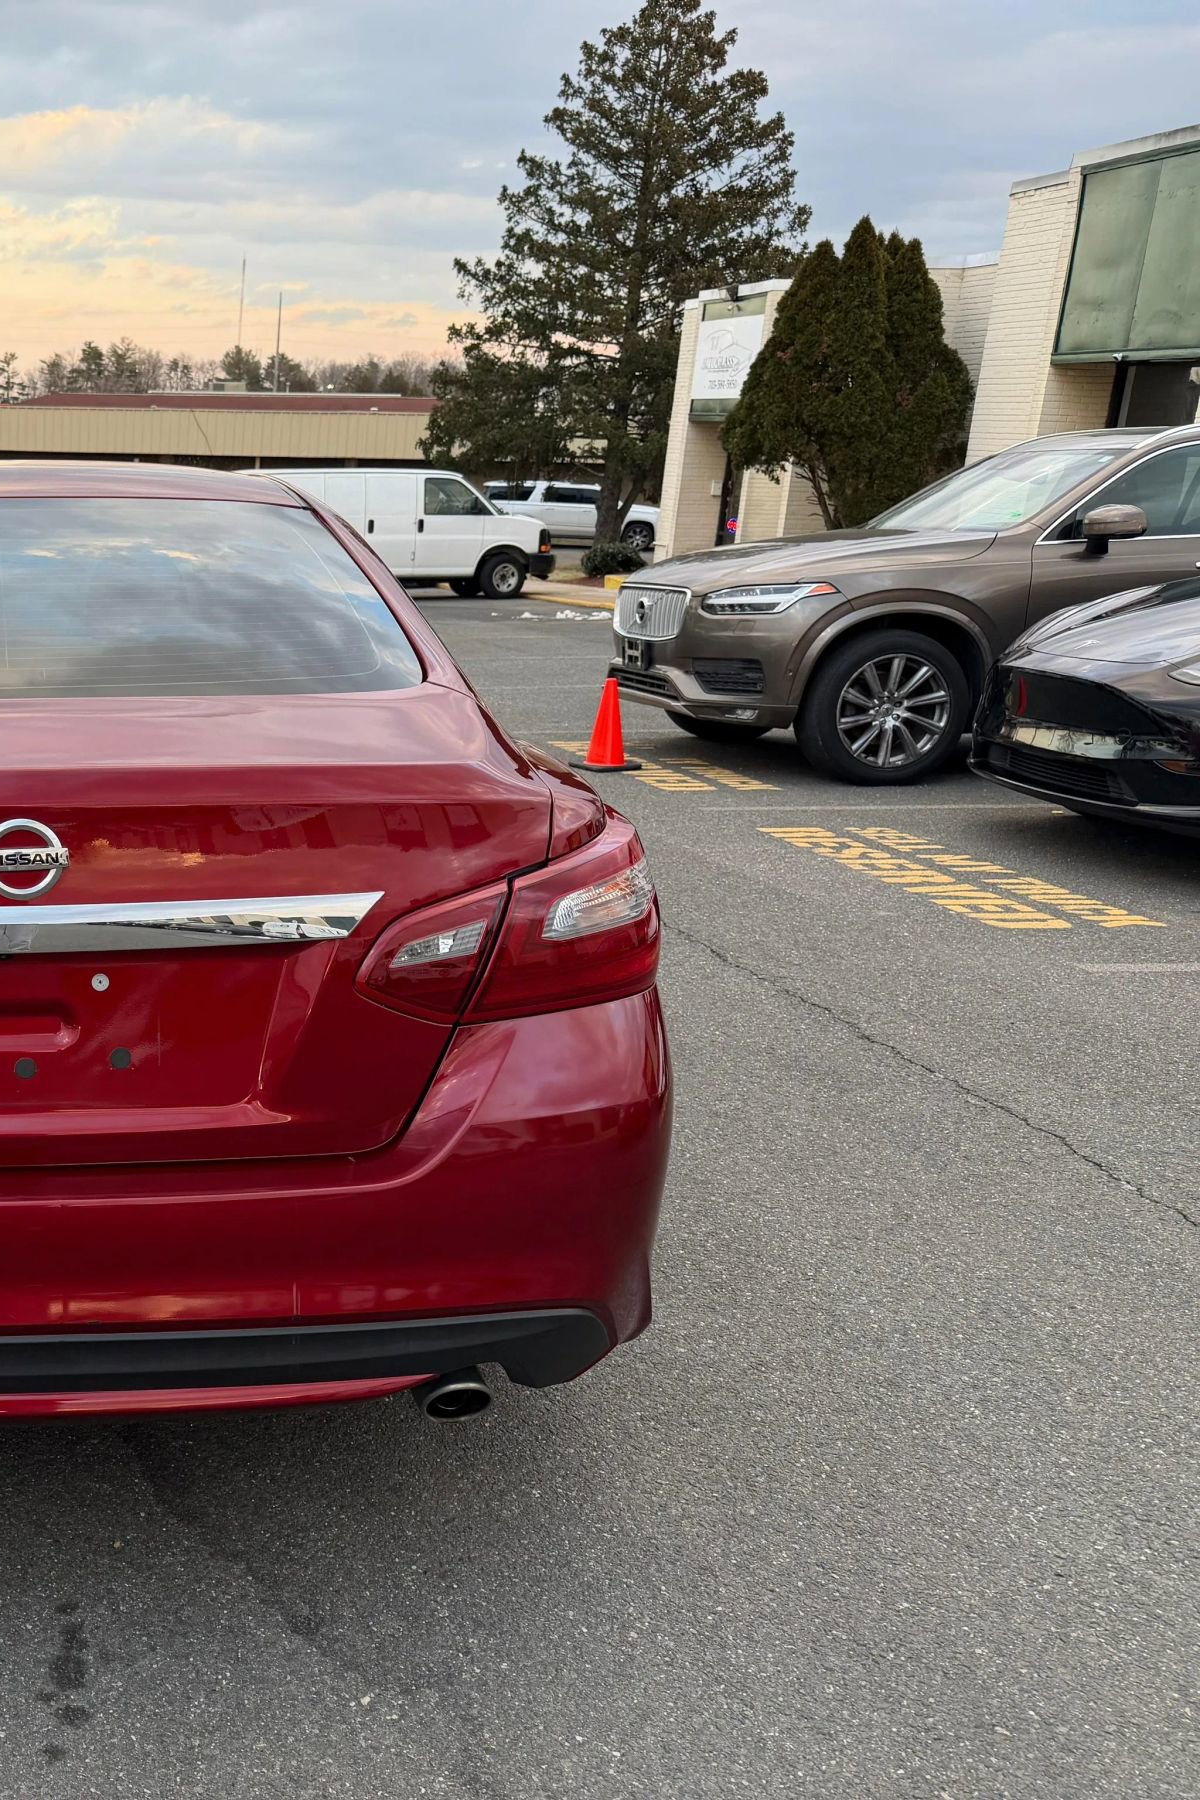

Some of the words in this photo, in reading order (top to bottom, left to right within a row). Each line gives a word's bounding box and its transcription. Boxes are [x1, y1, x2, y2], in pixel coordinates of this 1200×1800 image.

[756, 827, 1073, 929] RESERVED
[844, 827, 946, 852] SELL
[915, 854, 1017, 873] MY
[982, 876, 1169, 928] TRUCK
